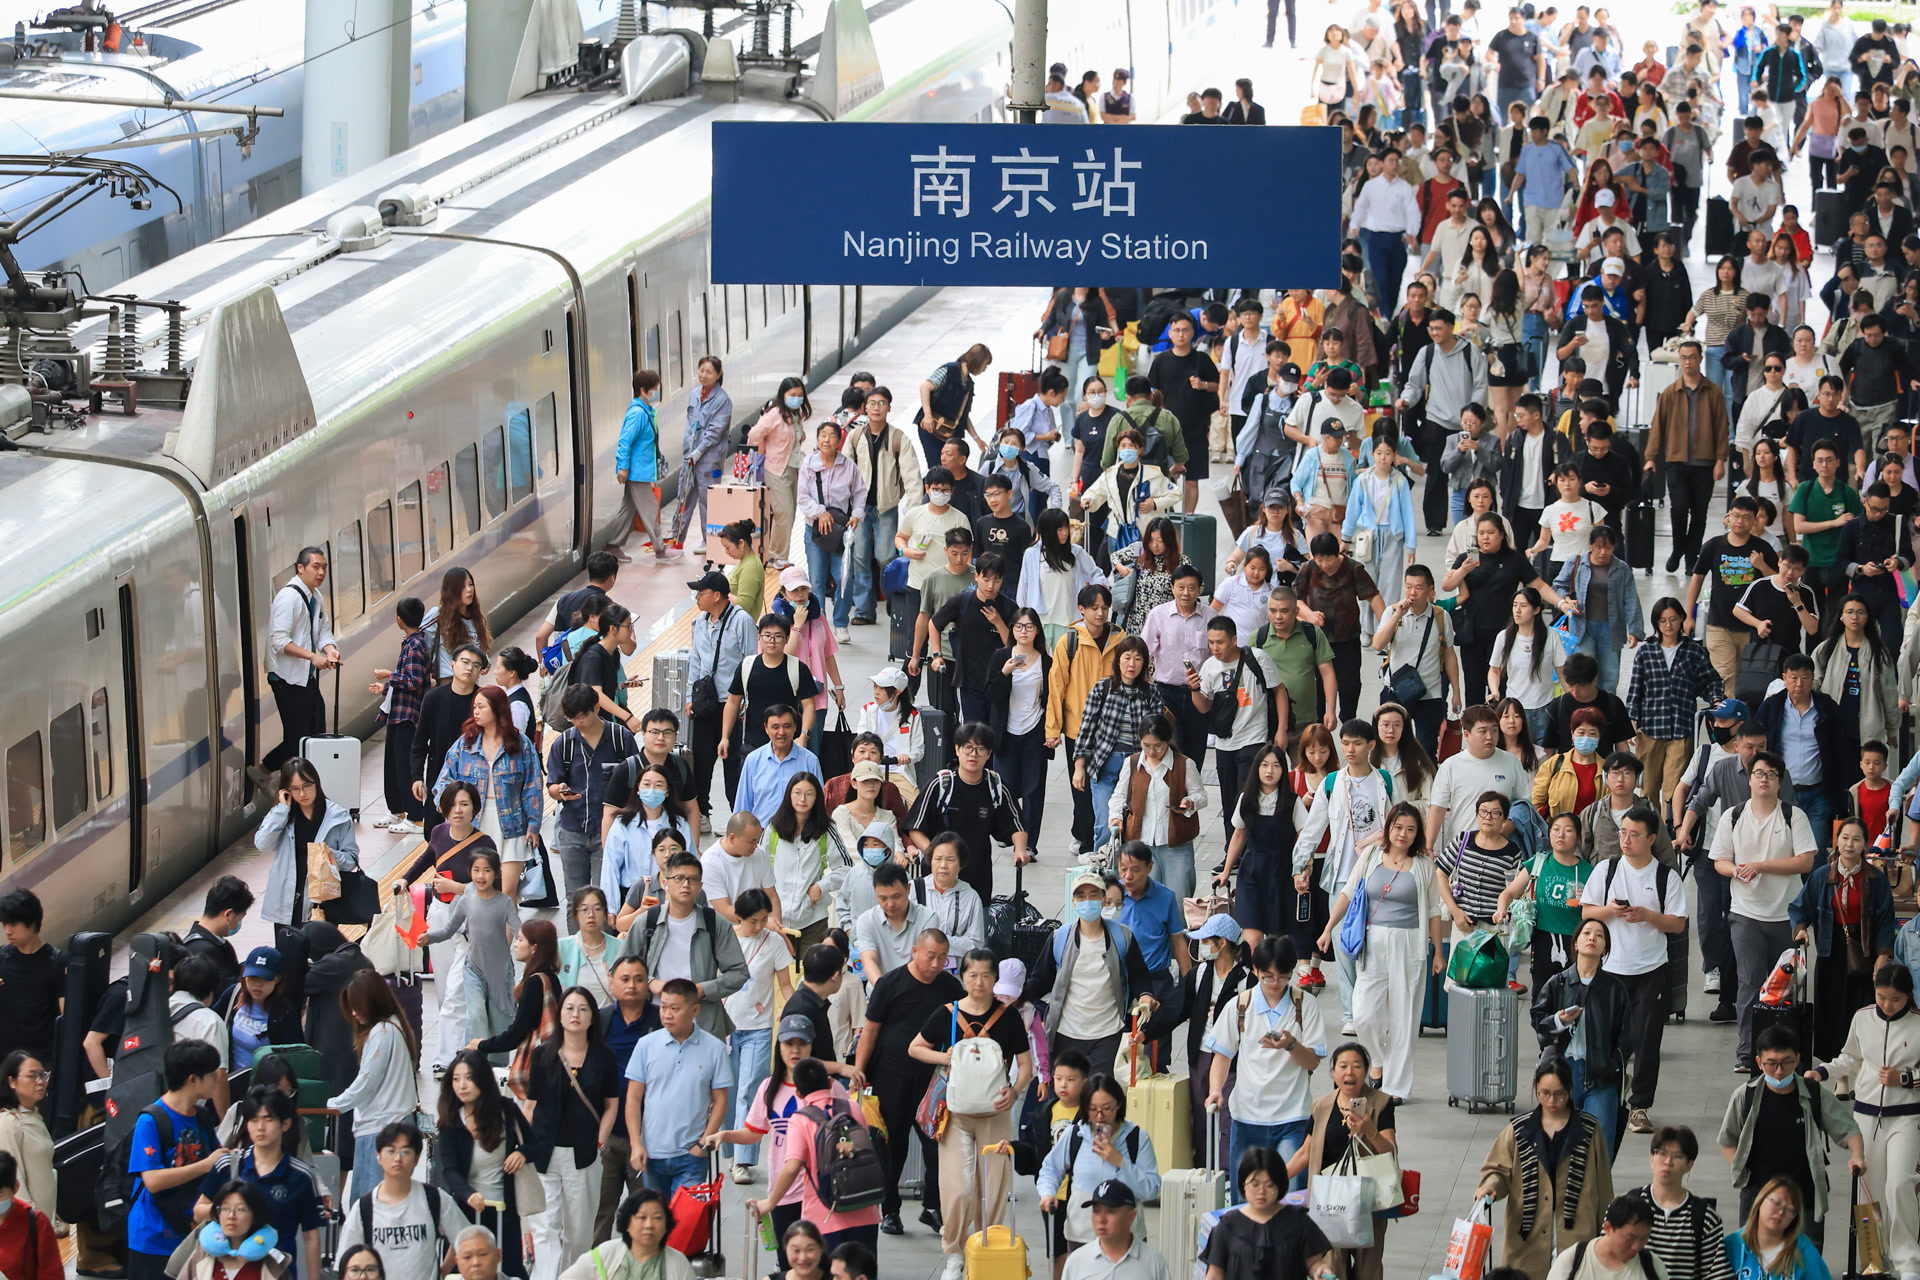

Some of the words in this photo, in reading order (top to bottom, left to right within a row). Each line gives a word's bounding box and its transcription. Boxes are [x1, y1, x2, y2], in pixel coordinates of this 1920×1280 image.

[334, 126, 344, 174] 115
[910, 145, 1142, 219] 南京站
[843, 230, 959, 266] Nanjing
[970, 231, 1092, 266] Railway
[1100, 232, 1208, 261] Station
[1551, 884, 1565, 899] C
